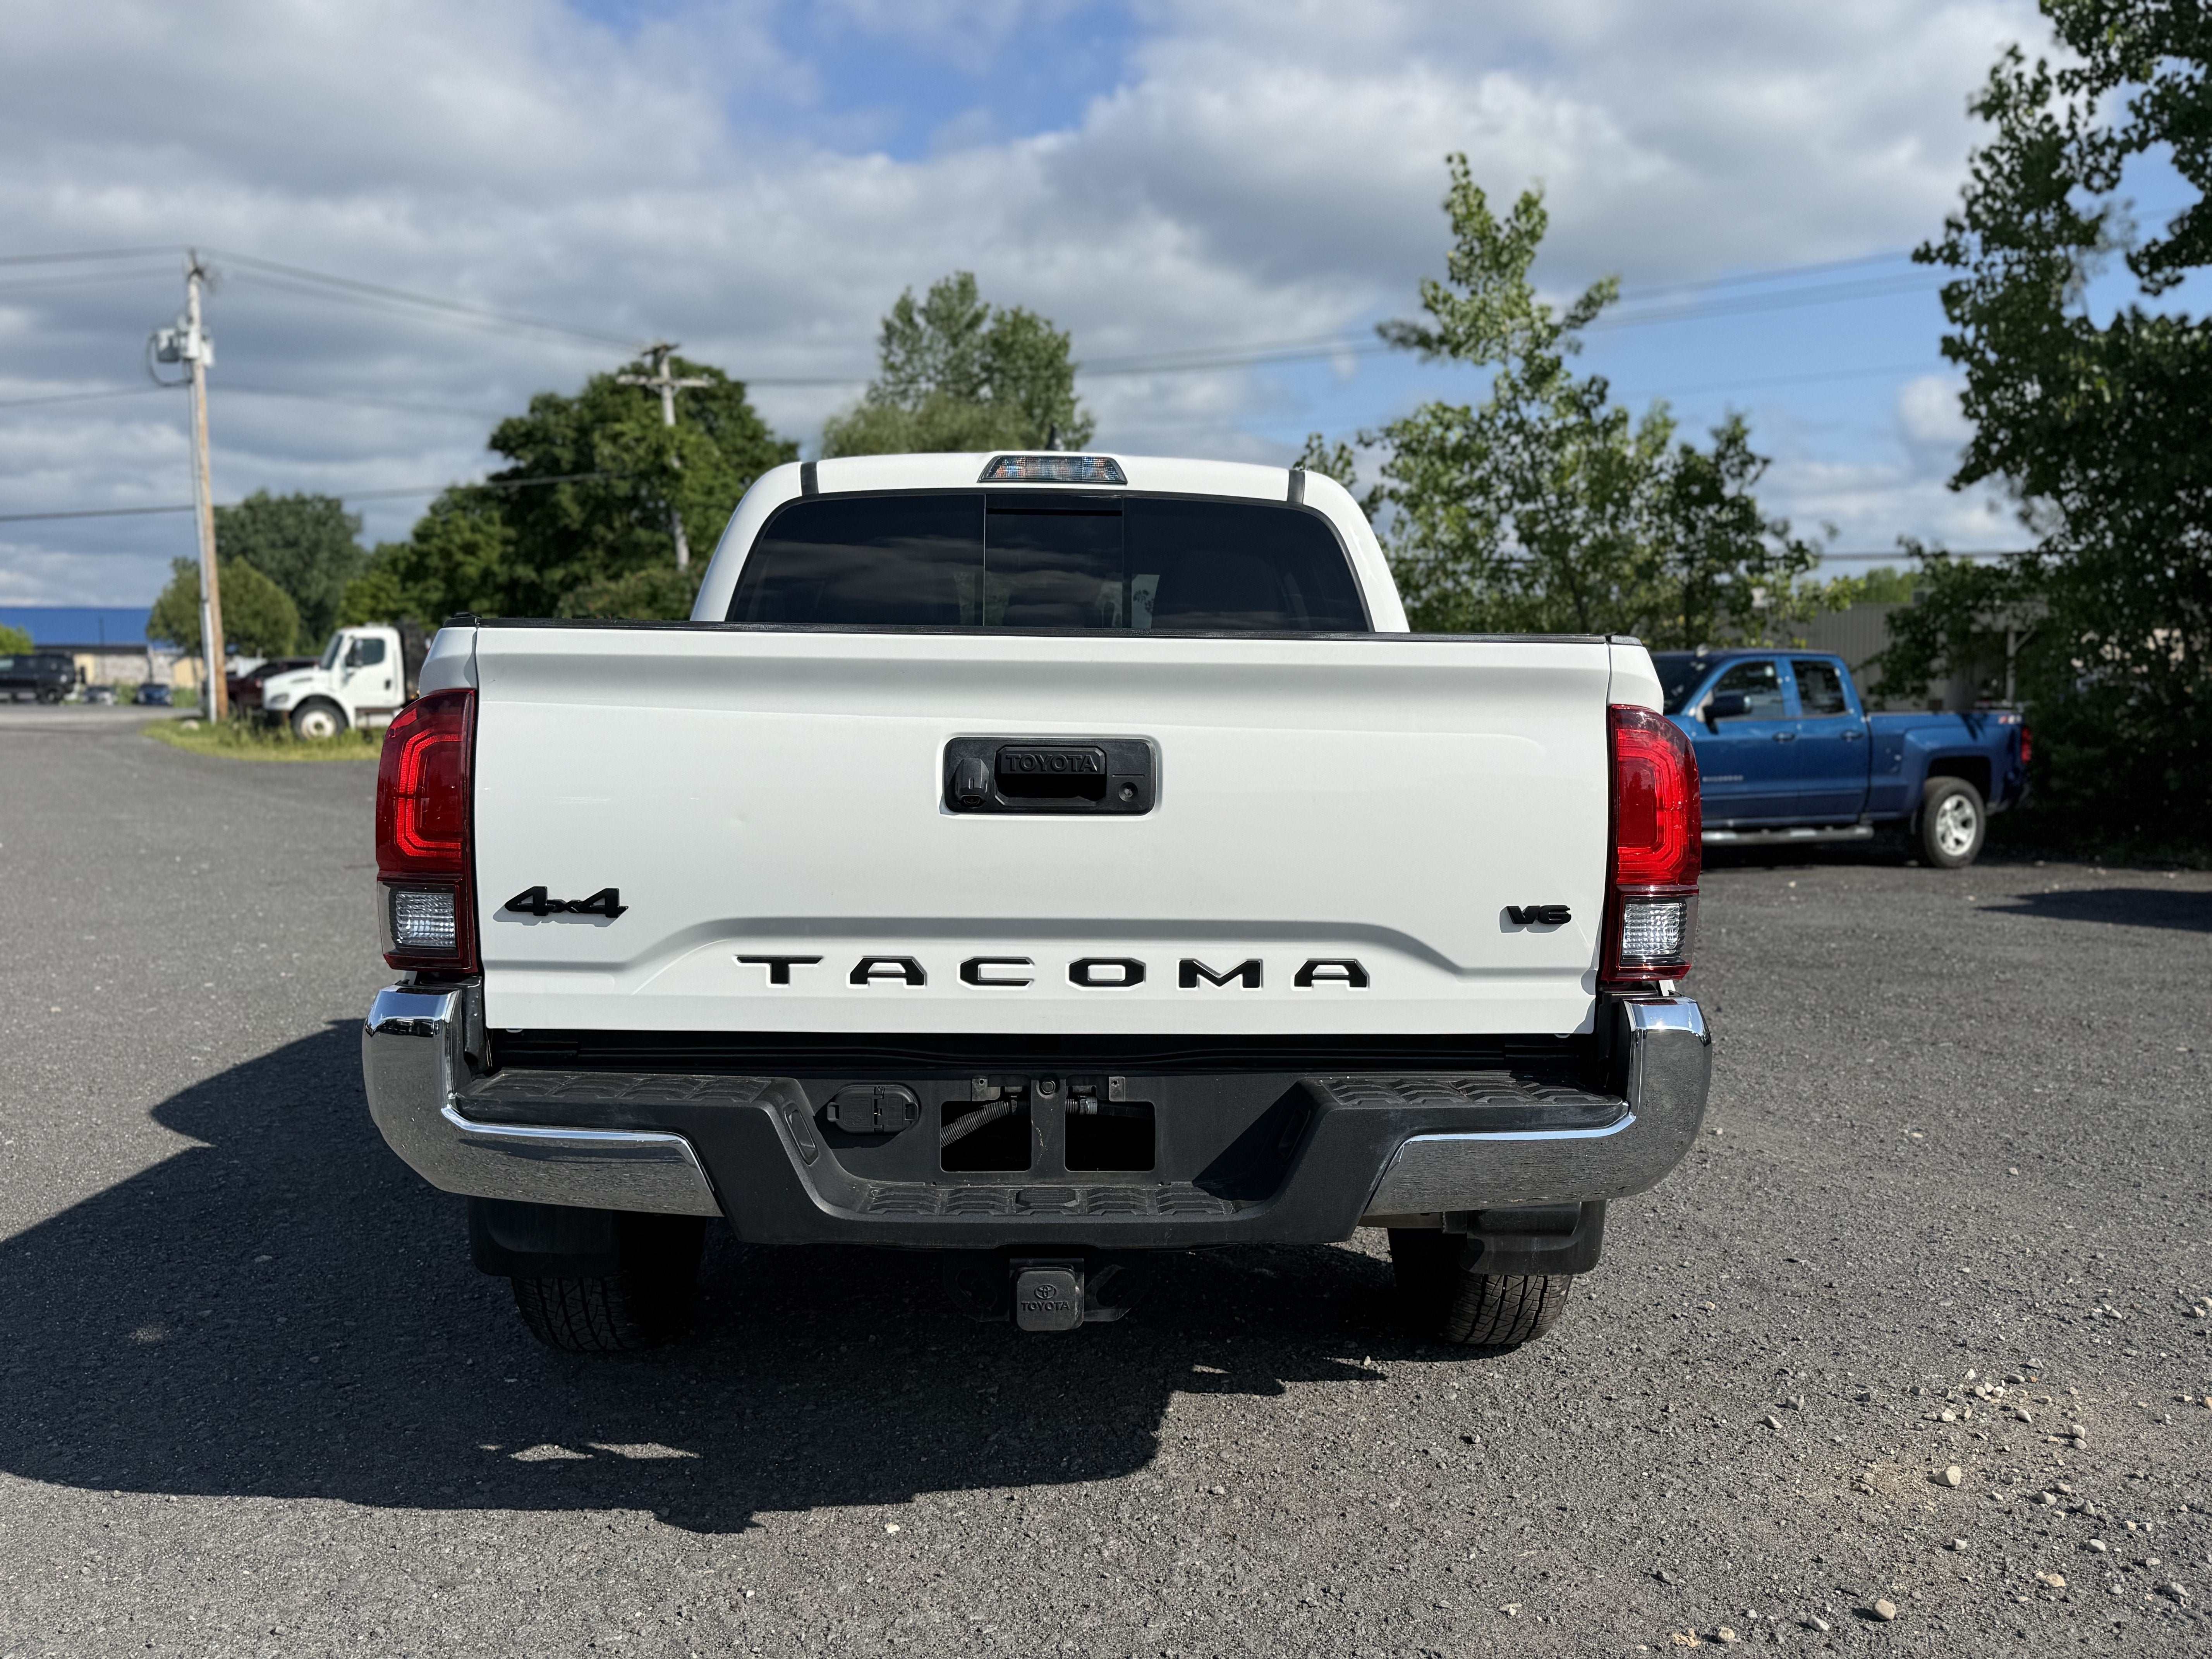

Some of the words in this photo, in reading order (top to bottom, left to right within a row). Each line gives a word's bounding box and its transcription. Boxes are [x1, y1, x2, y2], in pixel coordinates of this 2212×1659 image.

[1006, 754, 1097, 772] TOYOTA
[504, 886, 629, 918] 4x4
[1506, 905, 1571, 924] V6
[735, 955, 1369, 988] TACOMA
[1020, 1301, 1070, 1311] TOYOTA
